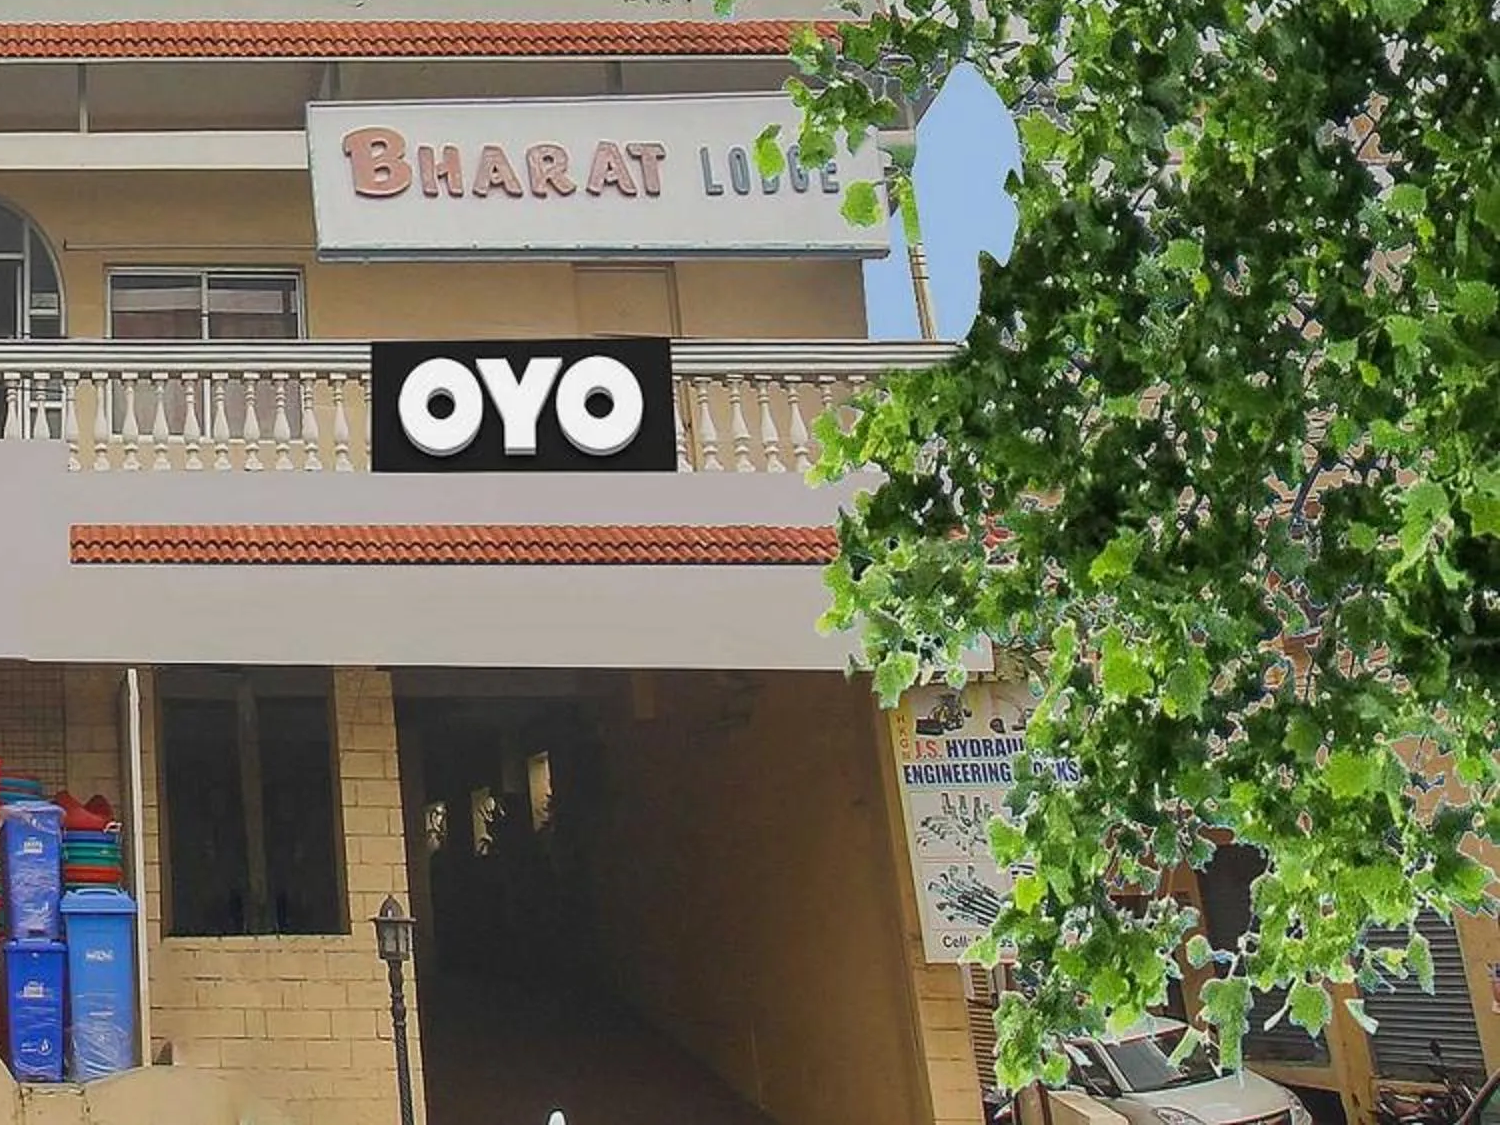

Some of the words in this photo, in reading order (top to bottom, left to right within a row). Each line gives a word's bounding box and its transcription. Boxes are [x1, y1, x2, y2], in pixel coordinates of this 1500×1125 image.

[342, 126, 666, 198] BHARAT
[700, 145, 840, 196] LOGE
[400, 356, 644, 457] OYO
[903, 762, 1013, 784] ENGINEERING
